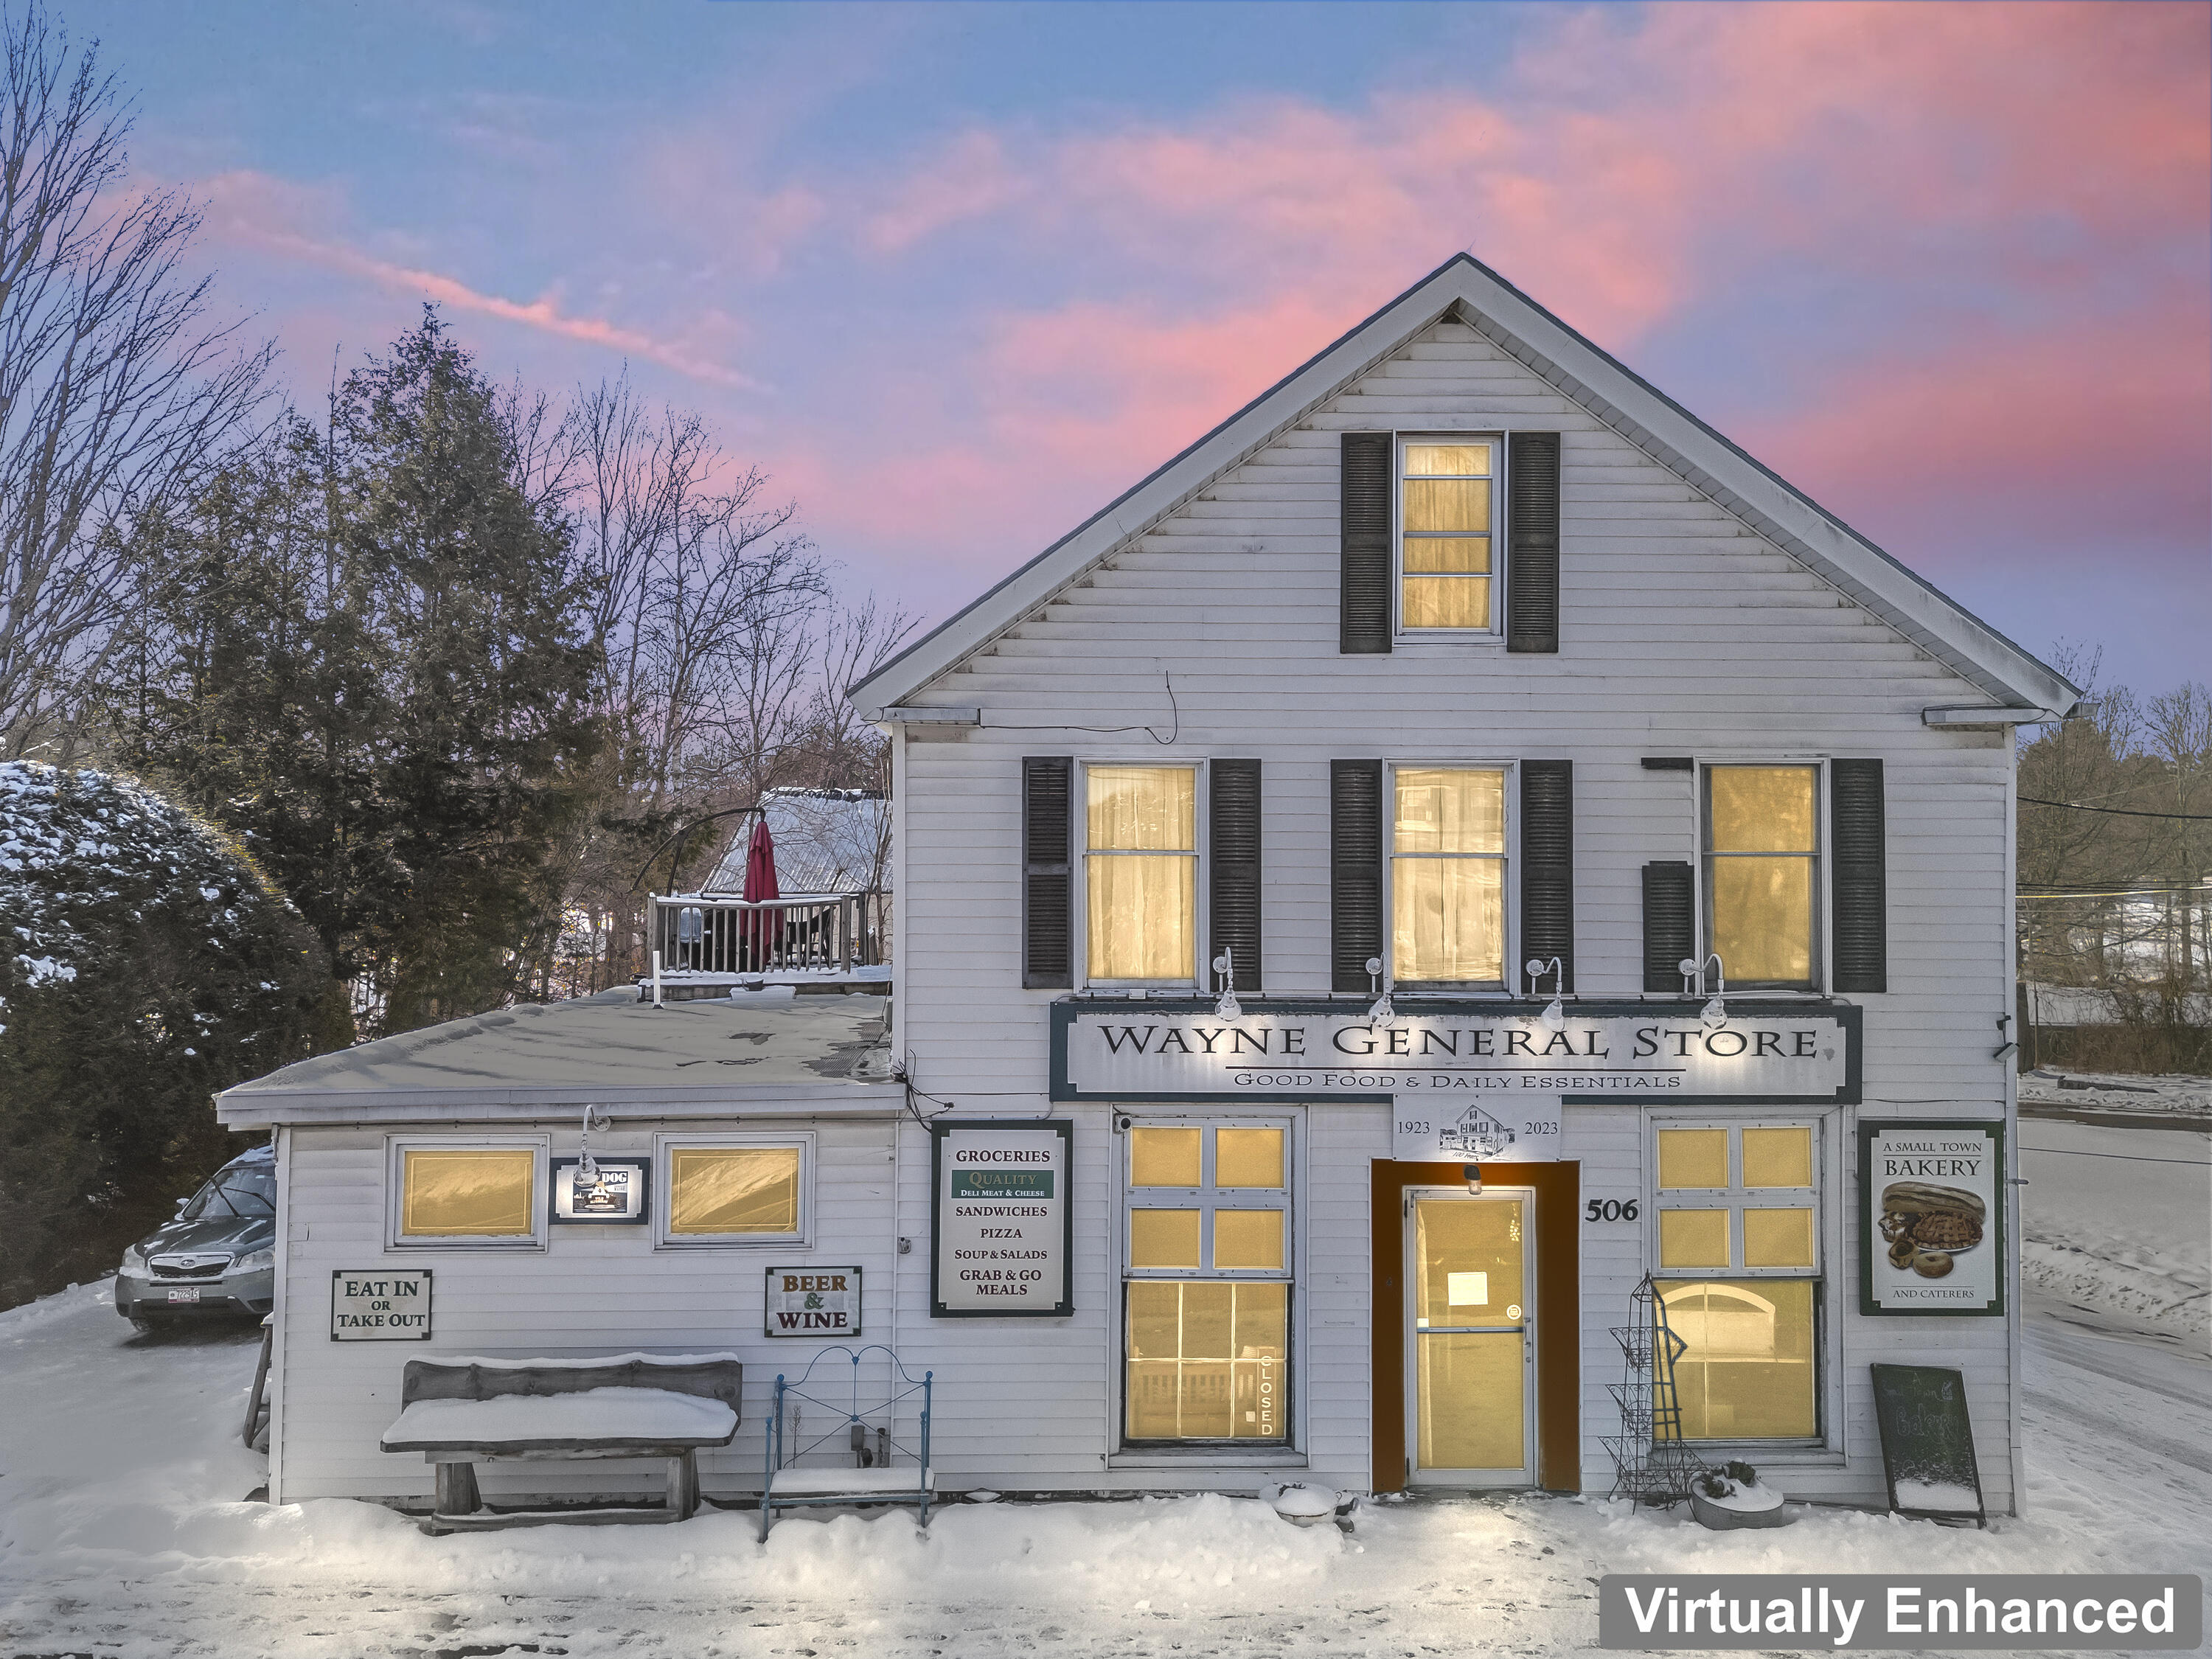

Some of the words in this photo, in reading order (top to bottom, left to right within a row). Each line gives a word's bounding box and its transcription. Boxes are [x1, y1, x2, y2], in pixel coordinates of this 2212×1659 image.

[1097, 1025, 1307, 1056] WAYNE
[1332, 1023, 1610, 1060] GENERAL
[1632, 1026, 1818, 1060] STORE
[1235, 1074, 1312, 1085] GOOD
[1322, 1074, 1395, 1087] FOOD
[1406, 1077, 1420, 1087] &
[1430, 1076, 1511, 1088] DAILY
[1521, 1077, 1680, 1088] ESSENTIALS
[1398, 1121, 1430, 1134] 1923
[1526, 1122, 1557, 1134] 2023
[1883, 1143, 1892, 1151] A
[1896, 1143, 1935, 1151] SMALL
[1940, 1143, 1981, 1151] TOWN
[956, 1150, 1049, 1162] GROCERIES
[1885, 1160, 1981, 1176] BAKERY
[602, 1172, 627, 1183] DOG
[969, 1172, 1038, 1188] QUALITY
[956, 1207, 1047, 1216] SANDWICHES
[1585, 1198, 1638, 1222] 506
[981, 1229, 1022, 1238] PIZZA
[955, 1250, 988, 1259] SOUP
[990, 1251, 998, 1259] &
[1001, 1250, 1047, 1259] SALADS
[960, 1270, 1001, 1280] GRAB
[1006, 1270, 1016, 1280] &
[1020, 1270, 1041, 1280] GO
[344, 1280, 389, 1297] EAT
[393, 1280, 420, 1297] IN
[782, 1275, 848, 1292] BEER
[976, 1284, 1027, 1295] MEALS
[1893, 1290, 1918, 1298] AND
[371, 1301, 391, 1310] OR
[804, 1292, 824, 1310] &
[336, 1314, 384, 1327] TAKE
[389, 1313, 425, 1326] OUT
[776, 1312, 849, 1329] WINE
[1260, 1355, 1272, 1435] CLOSED
